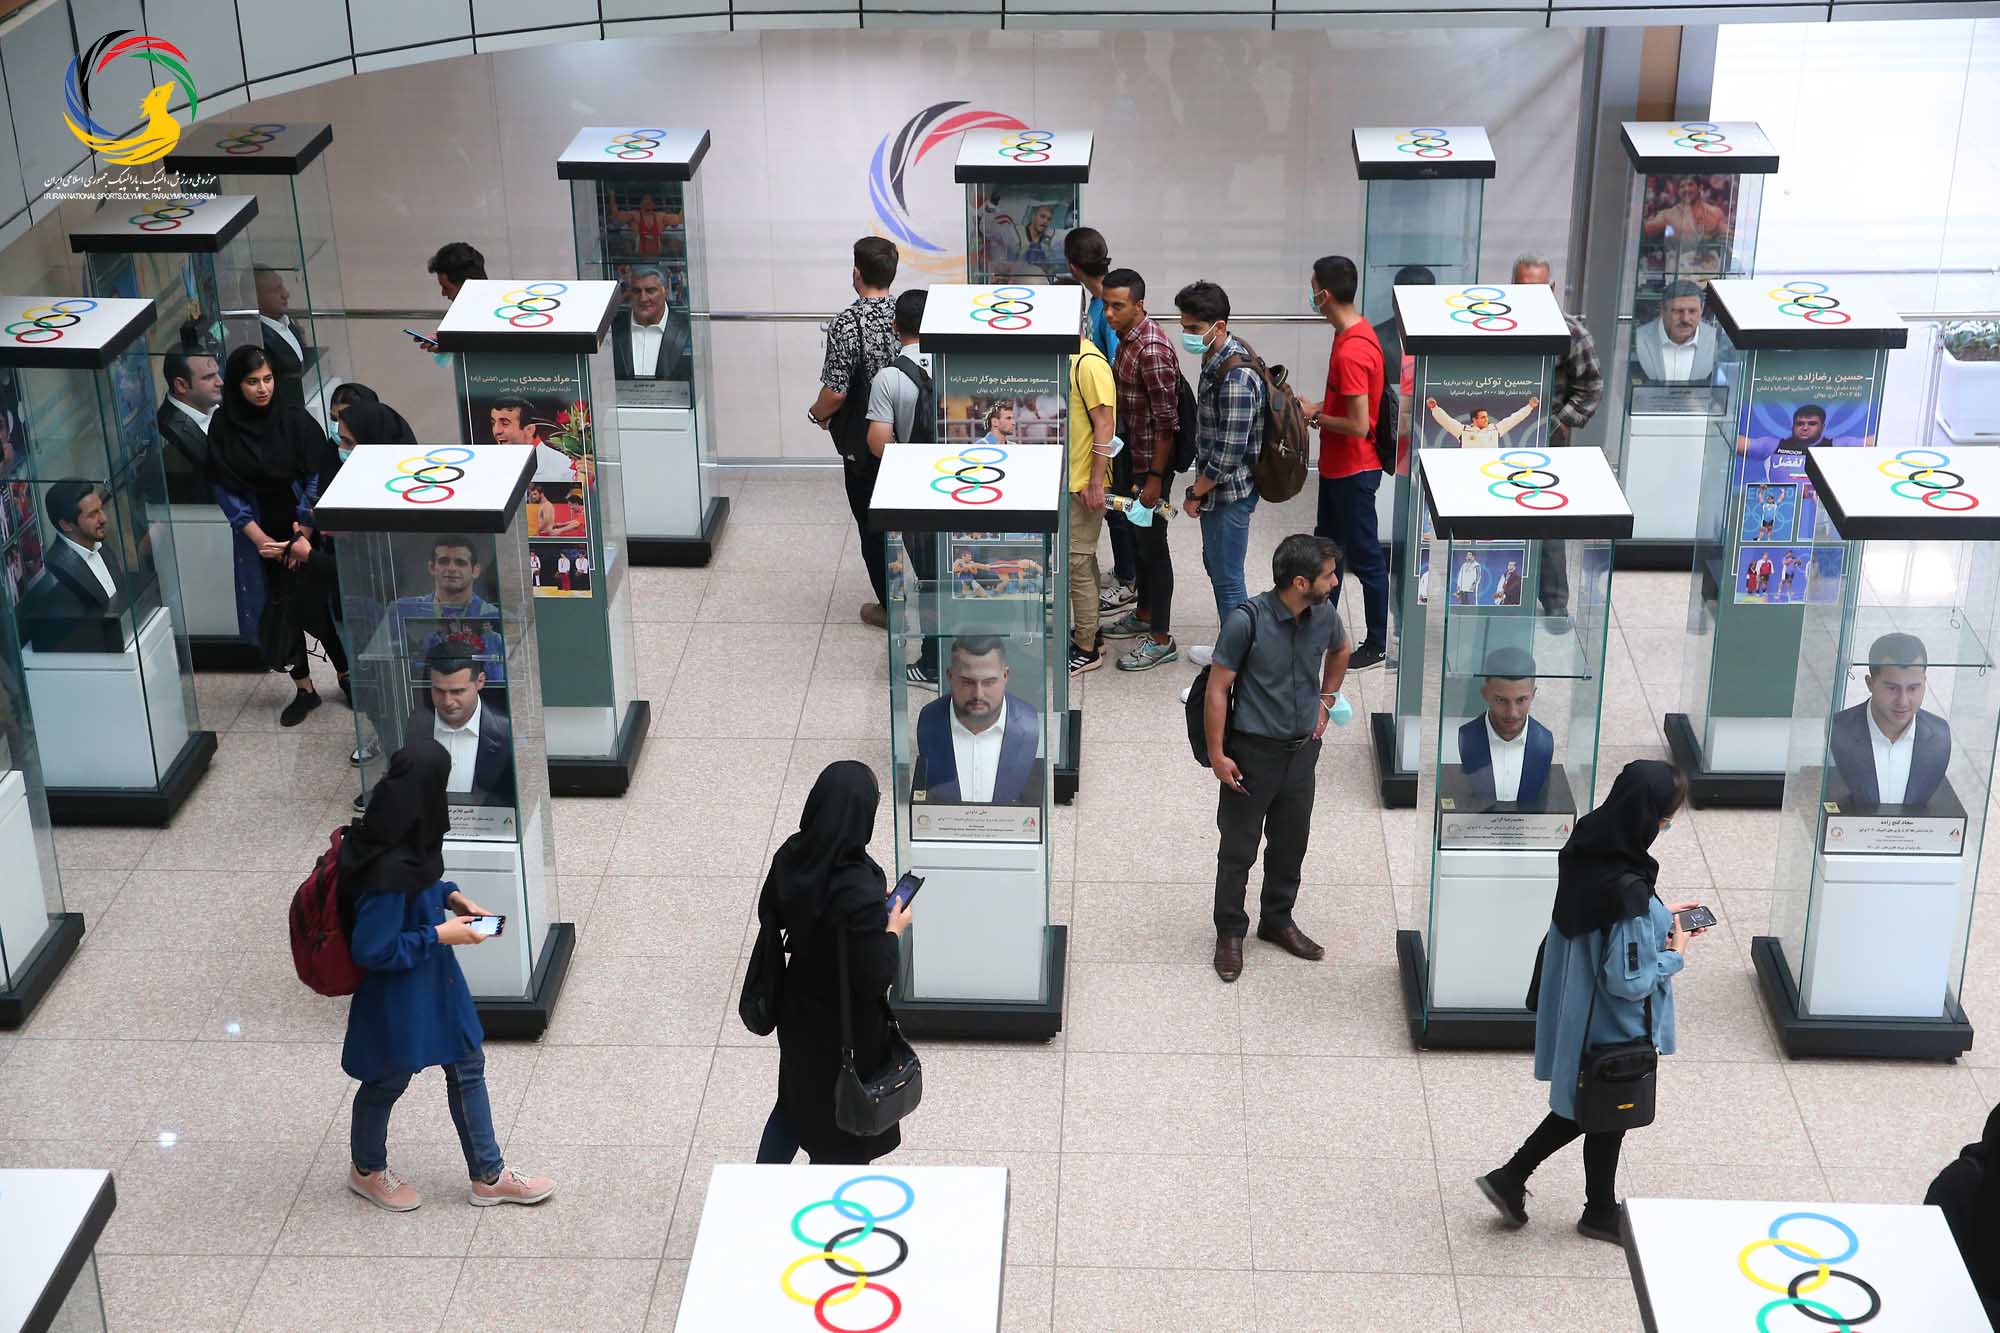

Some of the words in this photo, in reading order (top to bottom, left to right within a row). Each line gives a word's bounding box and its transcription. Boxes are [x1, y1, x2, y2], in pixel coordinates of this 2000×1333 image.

[519, 375, 552, 385] محمدی
[553, 374, 570, 385] مراد
[978, 375, 999, 385] جوکار
[1000, 376, 1028, 385] مصطفی
[1475, 376, 1502, 388] توکلی
[1504, 377, 1533, 388] حسین
[1797, 372, 1831, 383] رضازاده
[1835, 373, 1864, 383] حسین
